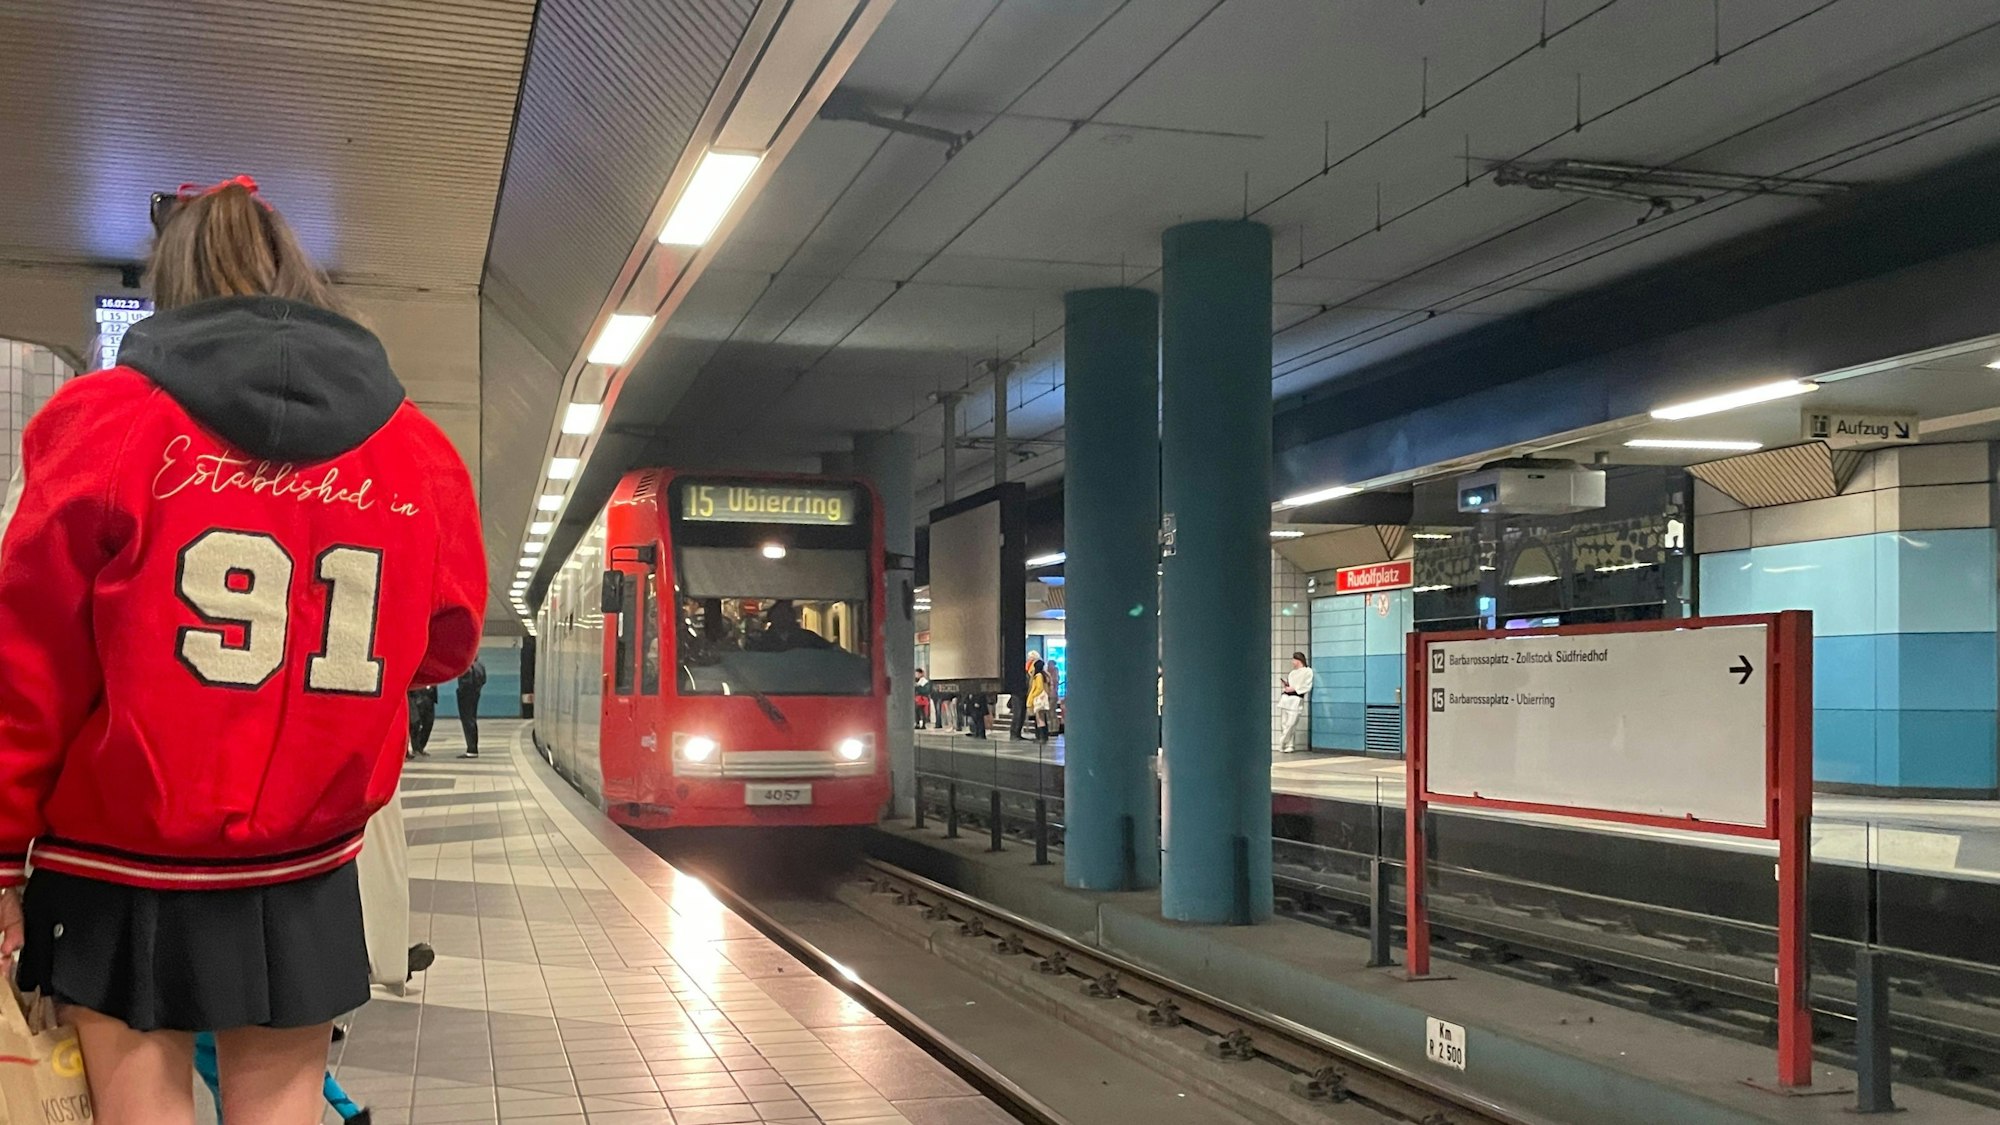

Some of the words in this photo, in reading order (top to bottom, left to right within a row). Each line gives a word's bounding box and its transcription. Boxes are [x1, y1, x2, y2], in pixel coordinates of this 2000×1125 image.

[102, 298, 140, 309] 16.02.23
[110, 312, 121, 320] 15
[110, 324, 120, 332] 12
[1836, 420, 1889, 439] Aufzug
[152, 434, 375, 510] Established
[390, 493, 419, 516] in
[690, 486, 714, 517] 15
[728, 487, 841, 521] Ubierring
[1347, 567, 1399, 587] Rudolfplatz
[174, 526, 384, 698] 91
[1432, 651, 1445, 672] 12
[1450, 652, 1509, 667] Barbarossaplatz
[1516, 651, 1553, 664] Zollstock
[1556, 649, 1608, 663] Südfriedhof
[1432, 690, 1445, 710] 15
[1450, 693, 1509, 707] Barbarossaplatz
[1516, 693, 1555, 708] Ubierring
[764, 789, 800, 801] 4057
[1439, 1022, 1452, 1041] Km
